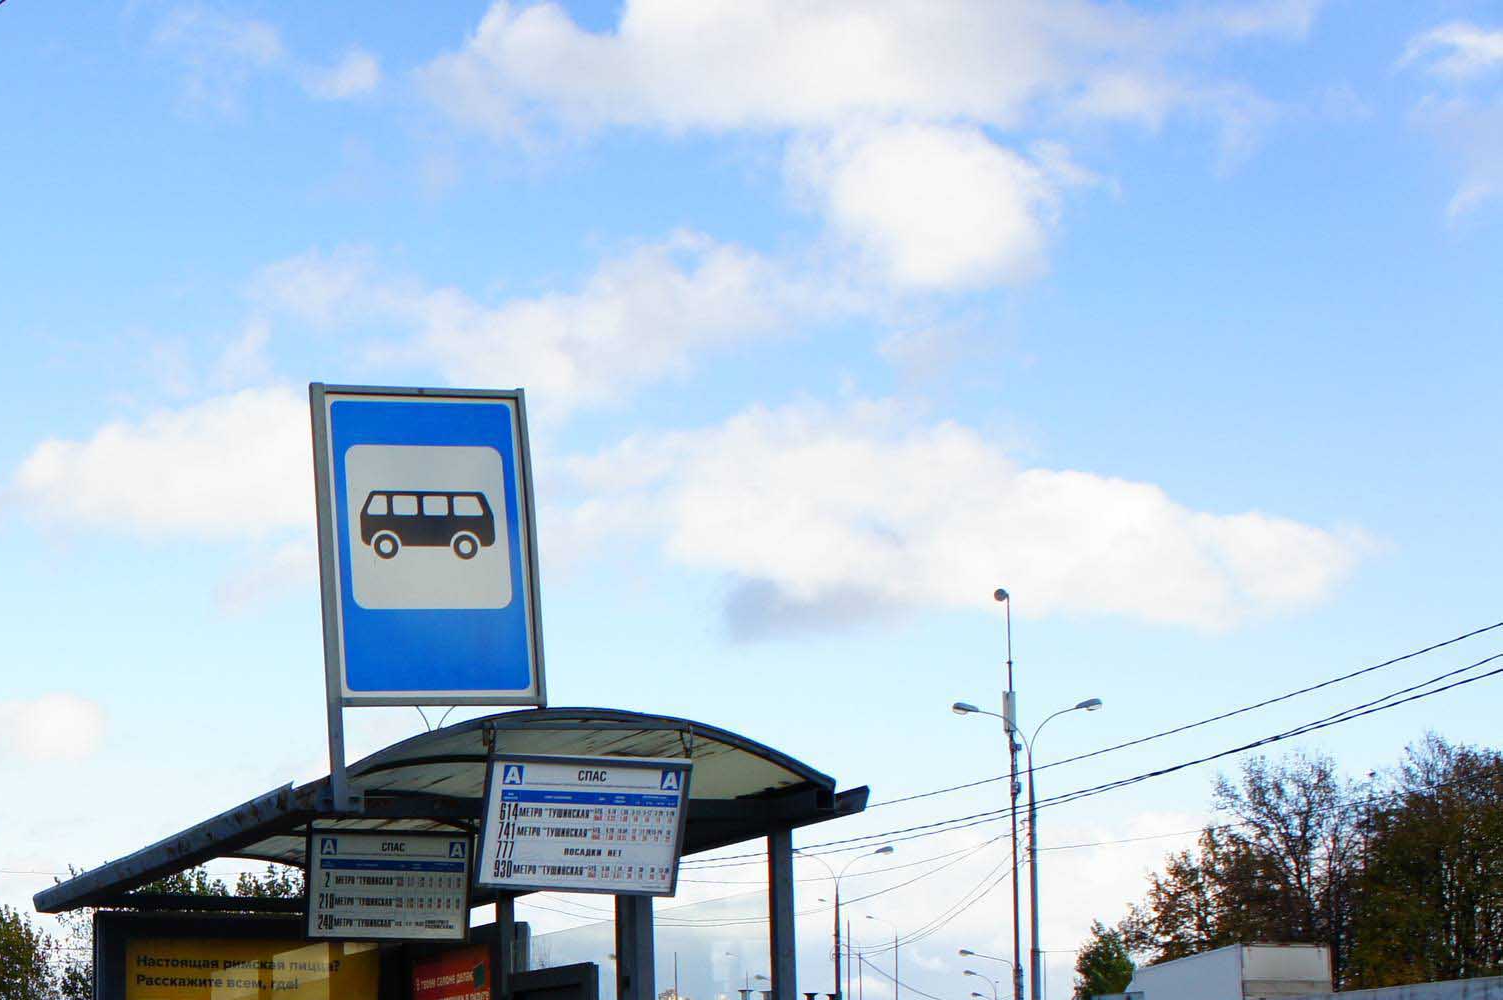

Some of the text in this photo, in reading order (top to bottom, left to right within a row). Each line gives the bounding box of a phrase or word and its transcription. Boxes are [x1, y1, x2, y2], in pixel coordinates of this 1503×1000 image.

[577, 770, 607, 782] СПАС
[499, 802, 518, 821] 614
[518, 807, 543, 818] МЕТРО
[498, 821, 516, 840] 741
[516, 826, 541, 837] МЕТРО
[381, 842, 406, 852] СПАС
[496, 840, 623, 859] 777 ПОСАДКИ НЕТ
[493, 860, 513, 879] 930
[512, 864, 537, 875] МЕТРО
[325, 871, 331, 888] 2
[335, 875, 355, 885] МЕТРО
[334, 896, 355, 906] МЕТРО
[333, 917, 354, 928] МЕТРО
[136, 955, 219, 970] Настоящая
[223, 959, 286, 972] римская
[136, 974, 223, 989] Расскажите
[226, 979, 267, 991] всем,
